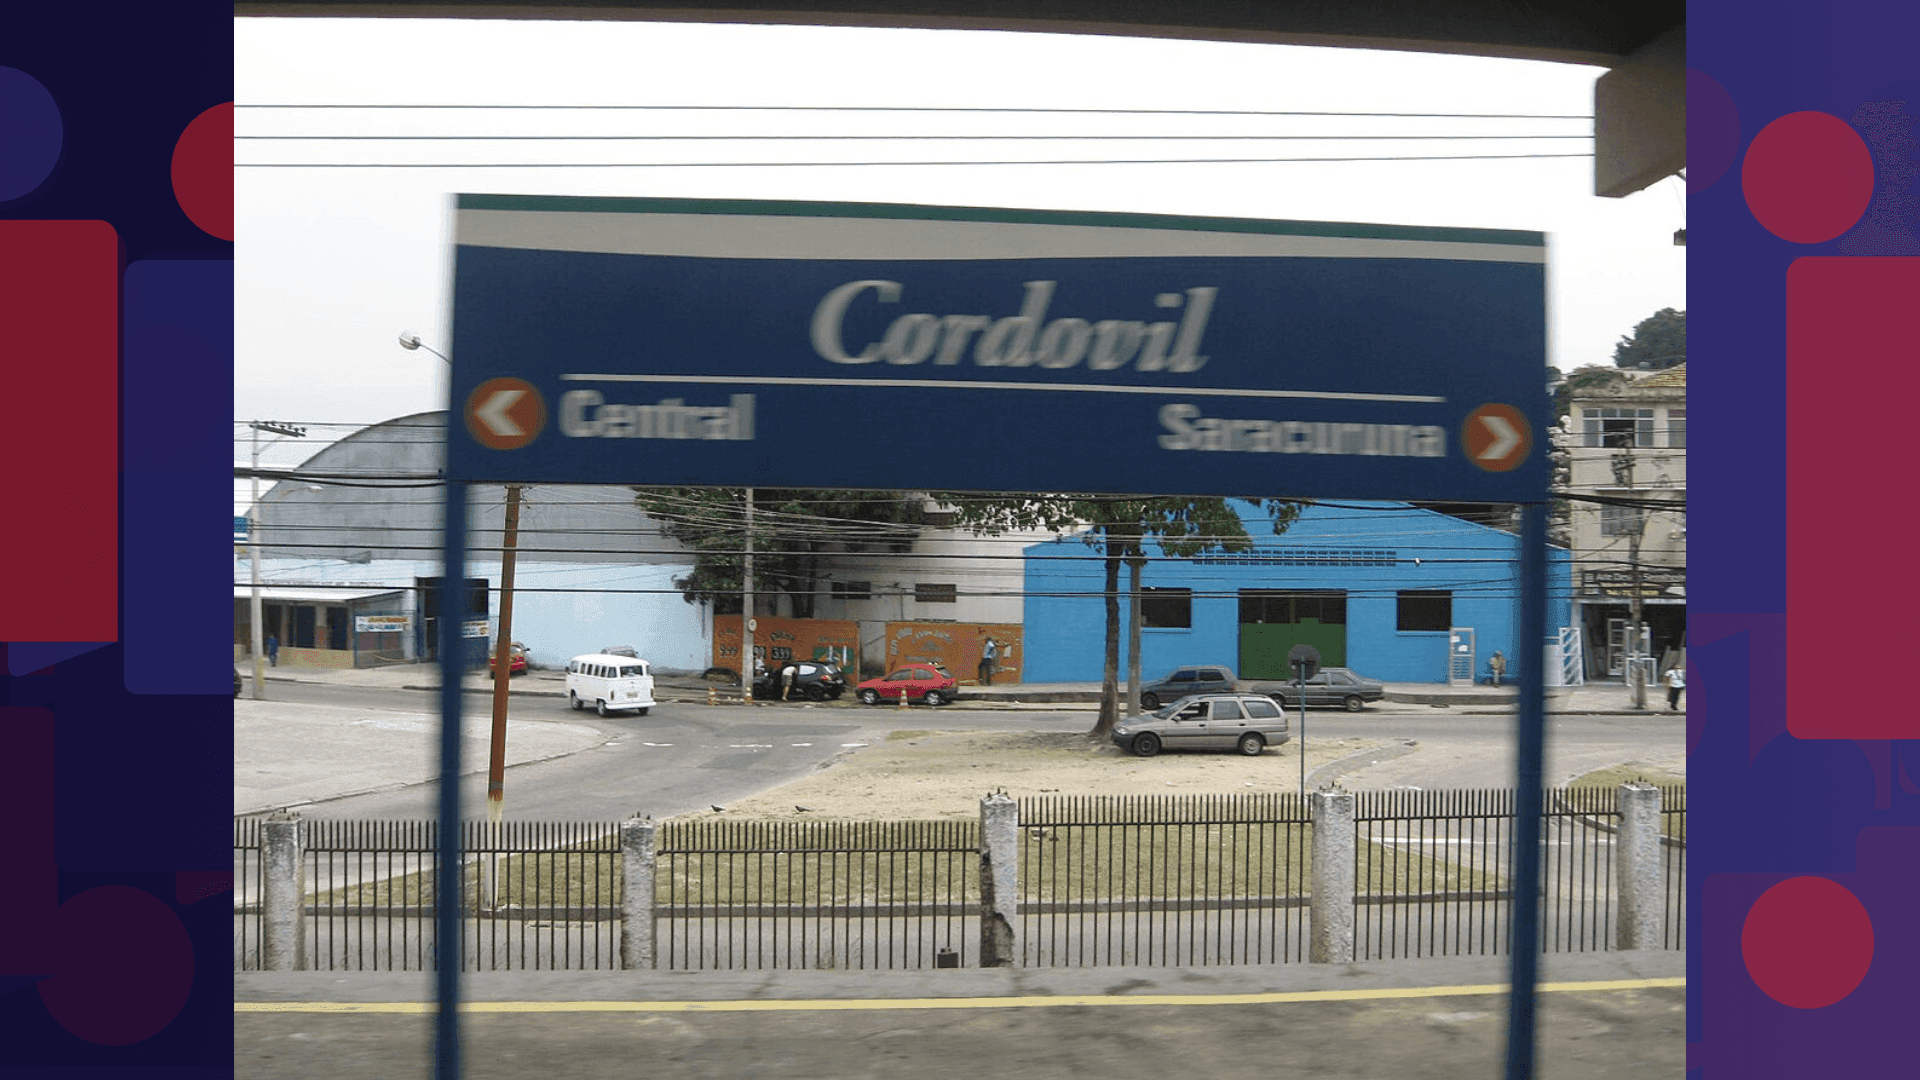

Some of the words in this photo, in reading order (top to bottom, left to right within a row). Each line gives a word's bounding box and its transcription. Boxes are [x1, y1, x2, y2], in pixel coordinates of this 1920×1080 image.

[809, 279, 1219, 372] Cordovil
[559, 389, 755, 440] Central
[1158, 403, 1447, 458] Saracuruna
